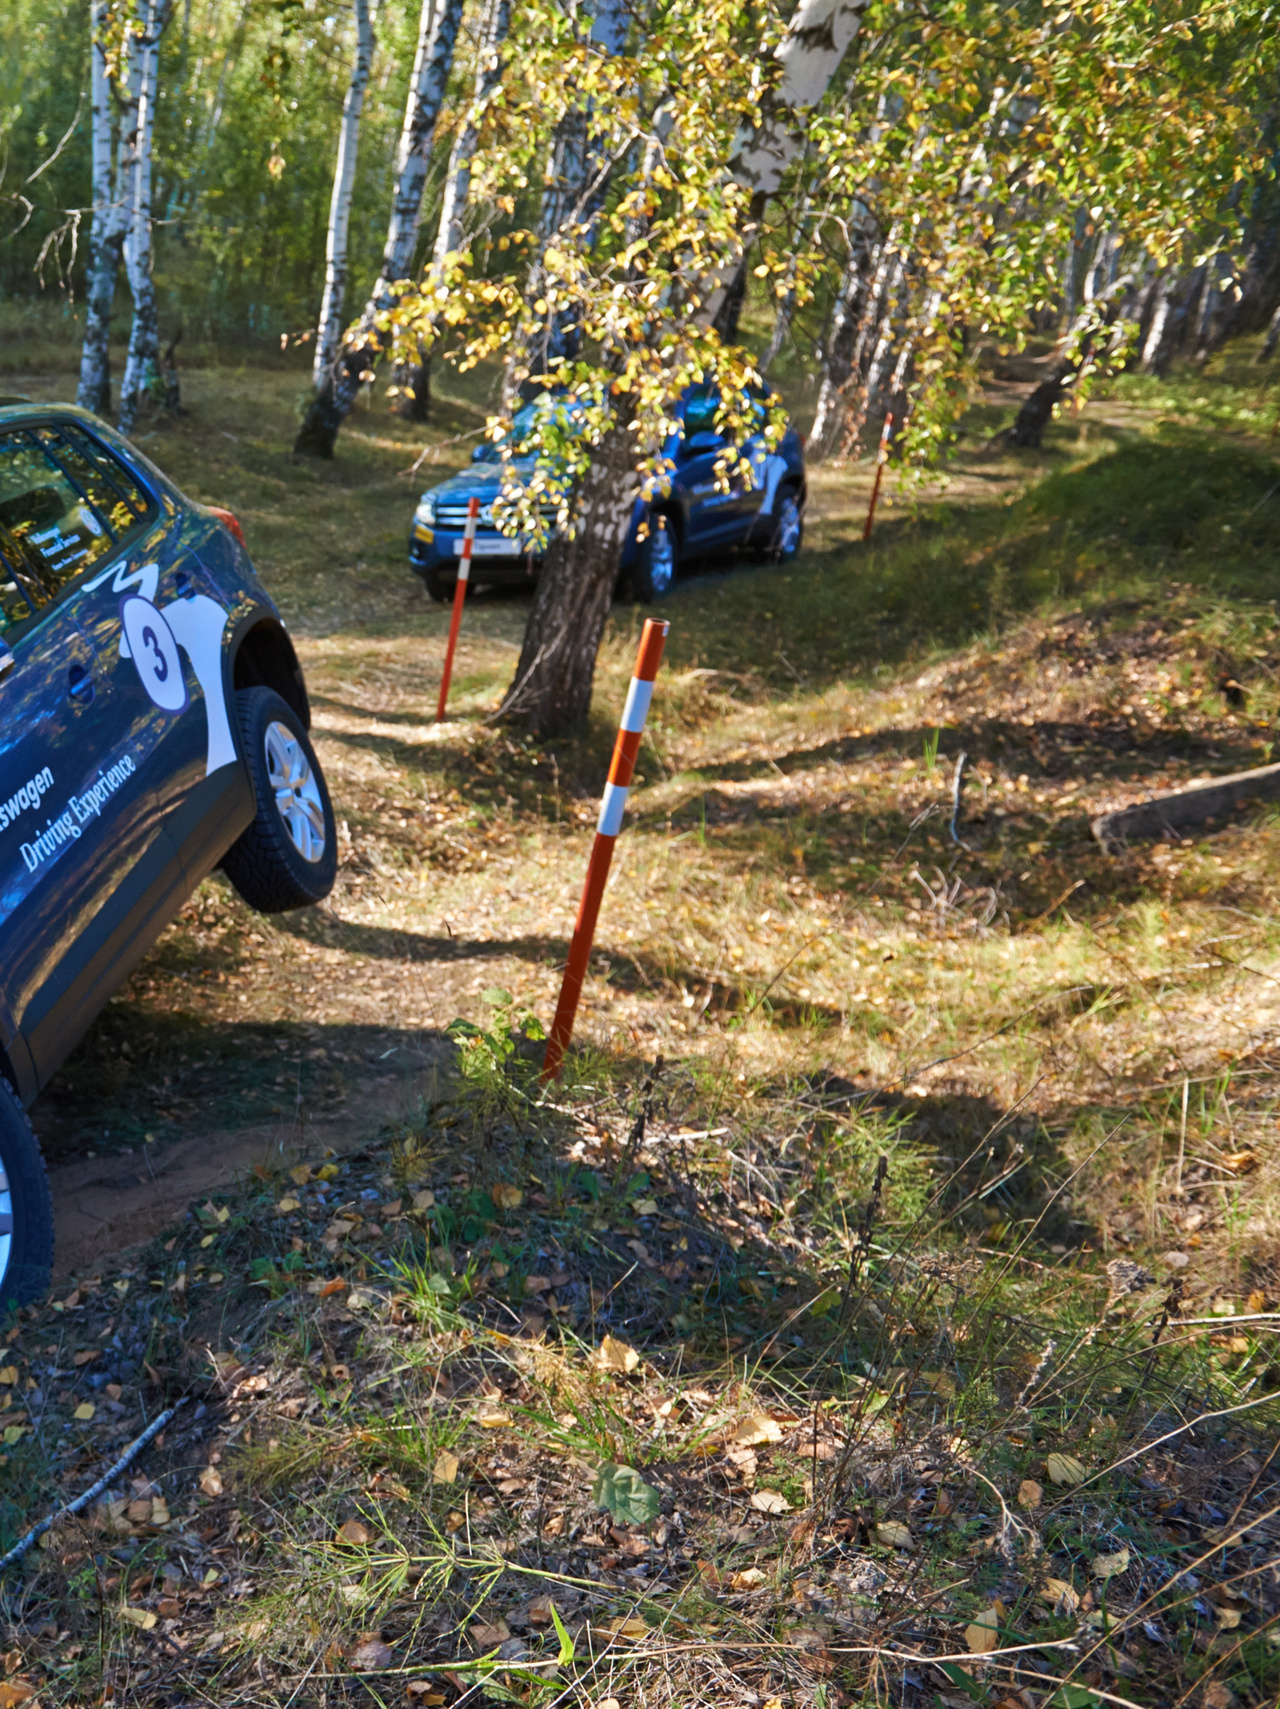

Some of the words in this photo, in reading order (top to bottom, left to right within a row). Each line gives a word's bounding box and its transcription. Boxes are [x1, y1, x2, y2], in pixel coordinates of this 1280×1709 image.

[142, 625, 169, 682] 3
[19, 819, 82, 873] Driving
[67, 754, 136, 817] Experience
